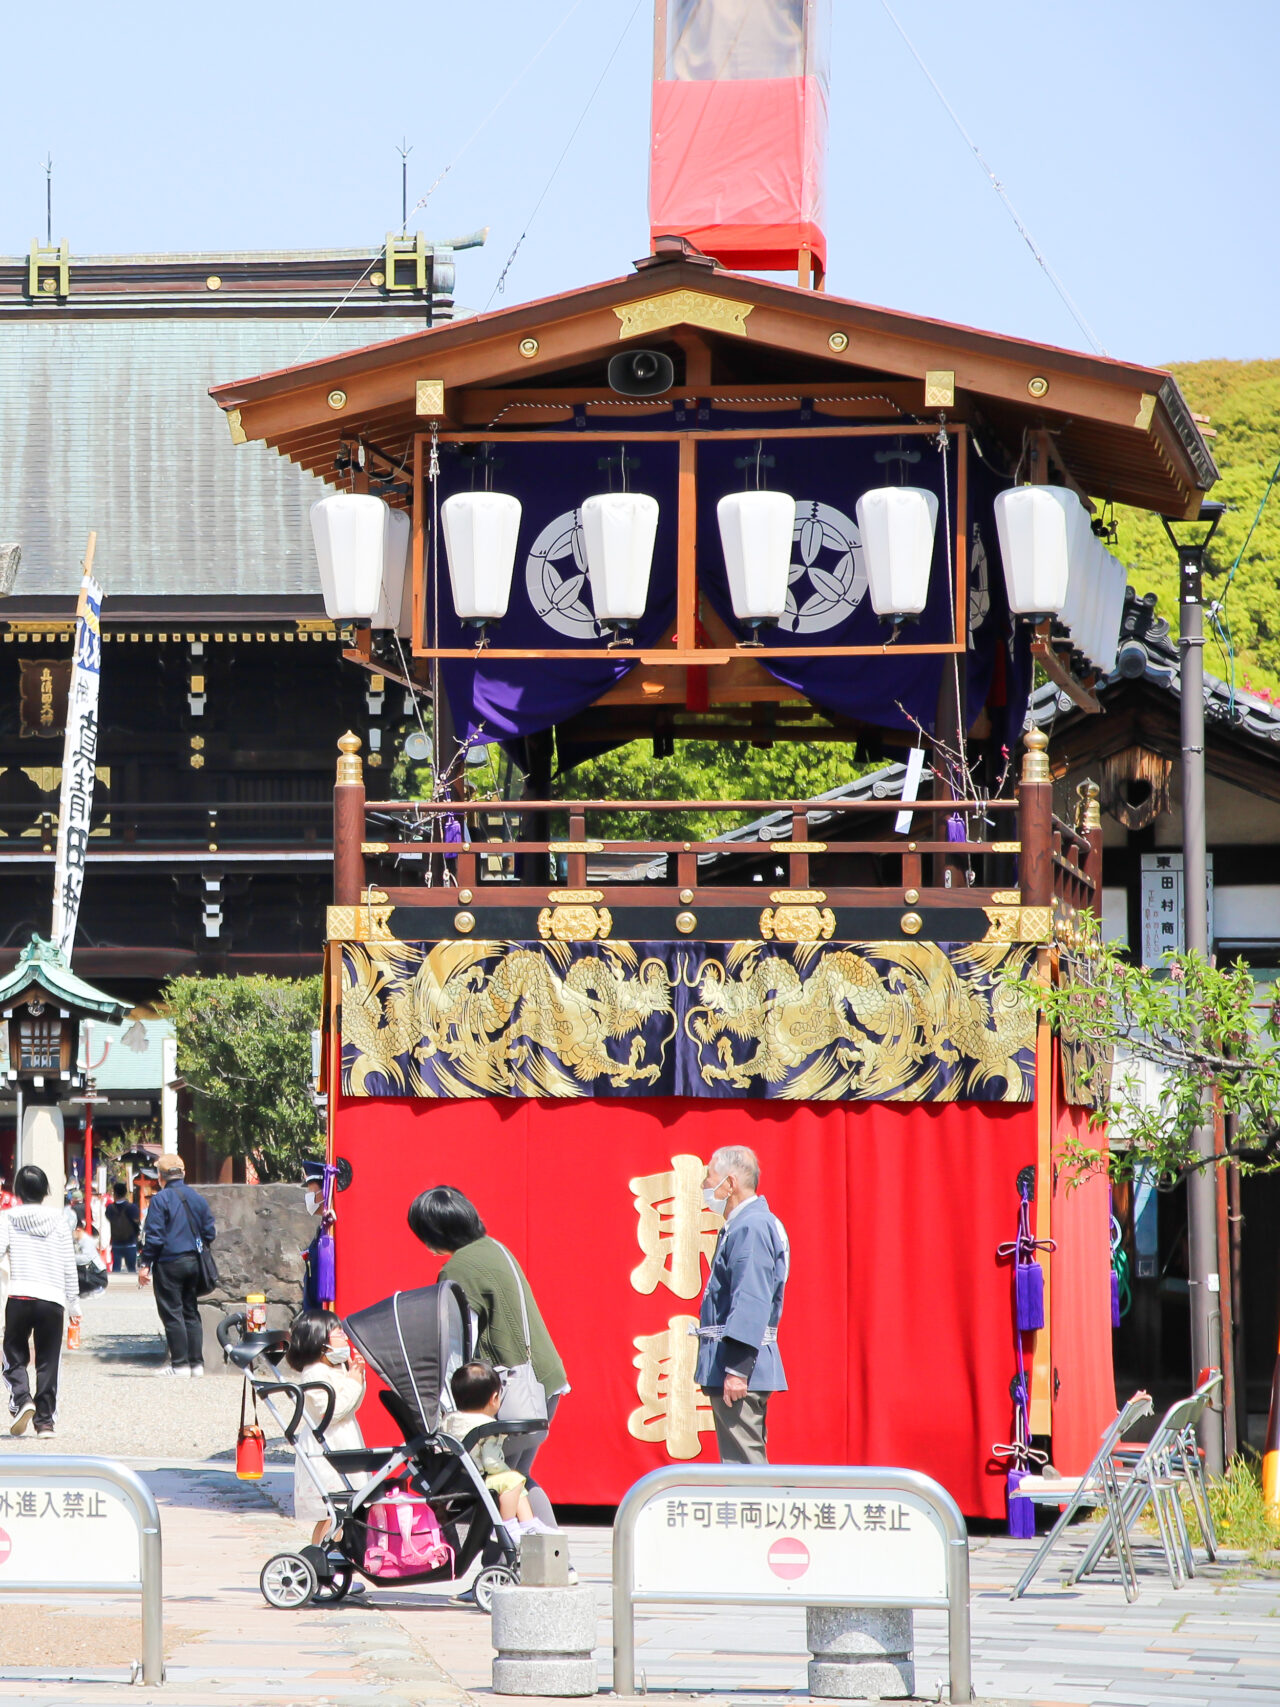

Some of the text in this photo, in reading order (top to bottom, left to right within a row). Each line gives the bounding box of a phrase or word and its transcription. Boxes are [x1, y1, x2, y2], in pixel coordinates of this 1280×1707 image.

[1156, 856, 1172, 869] 東
[666, 1500, 912, 1532] 許可車両以外進入禁止
